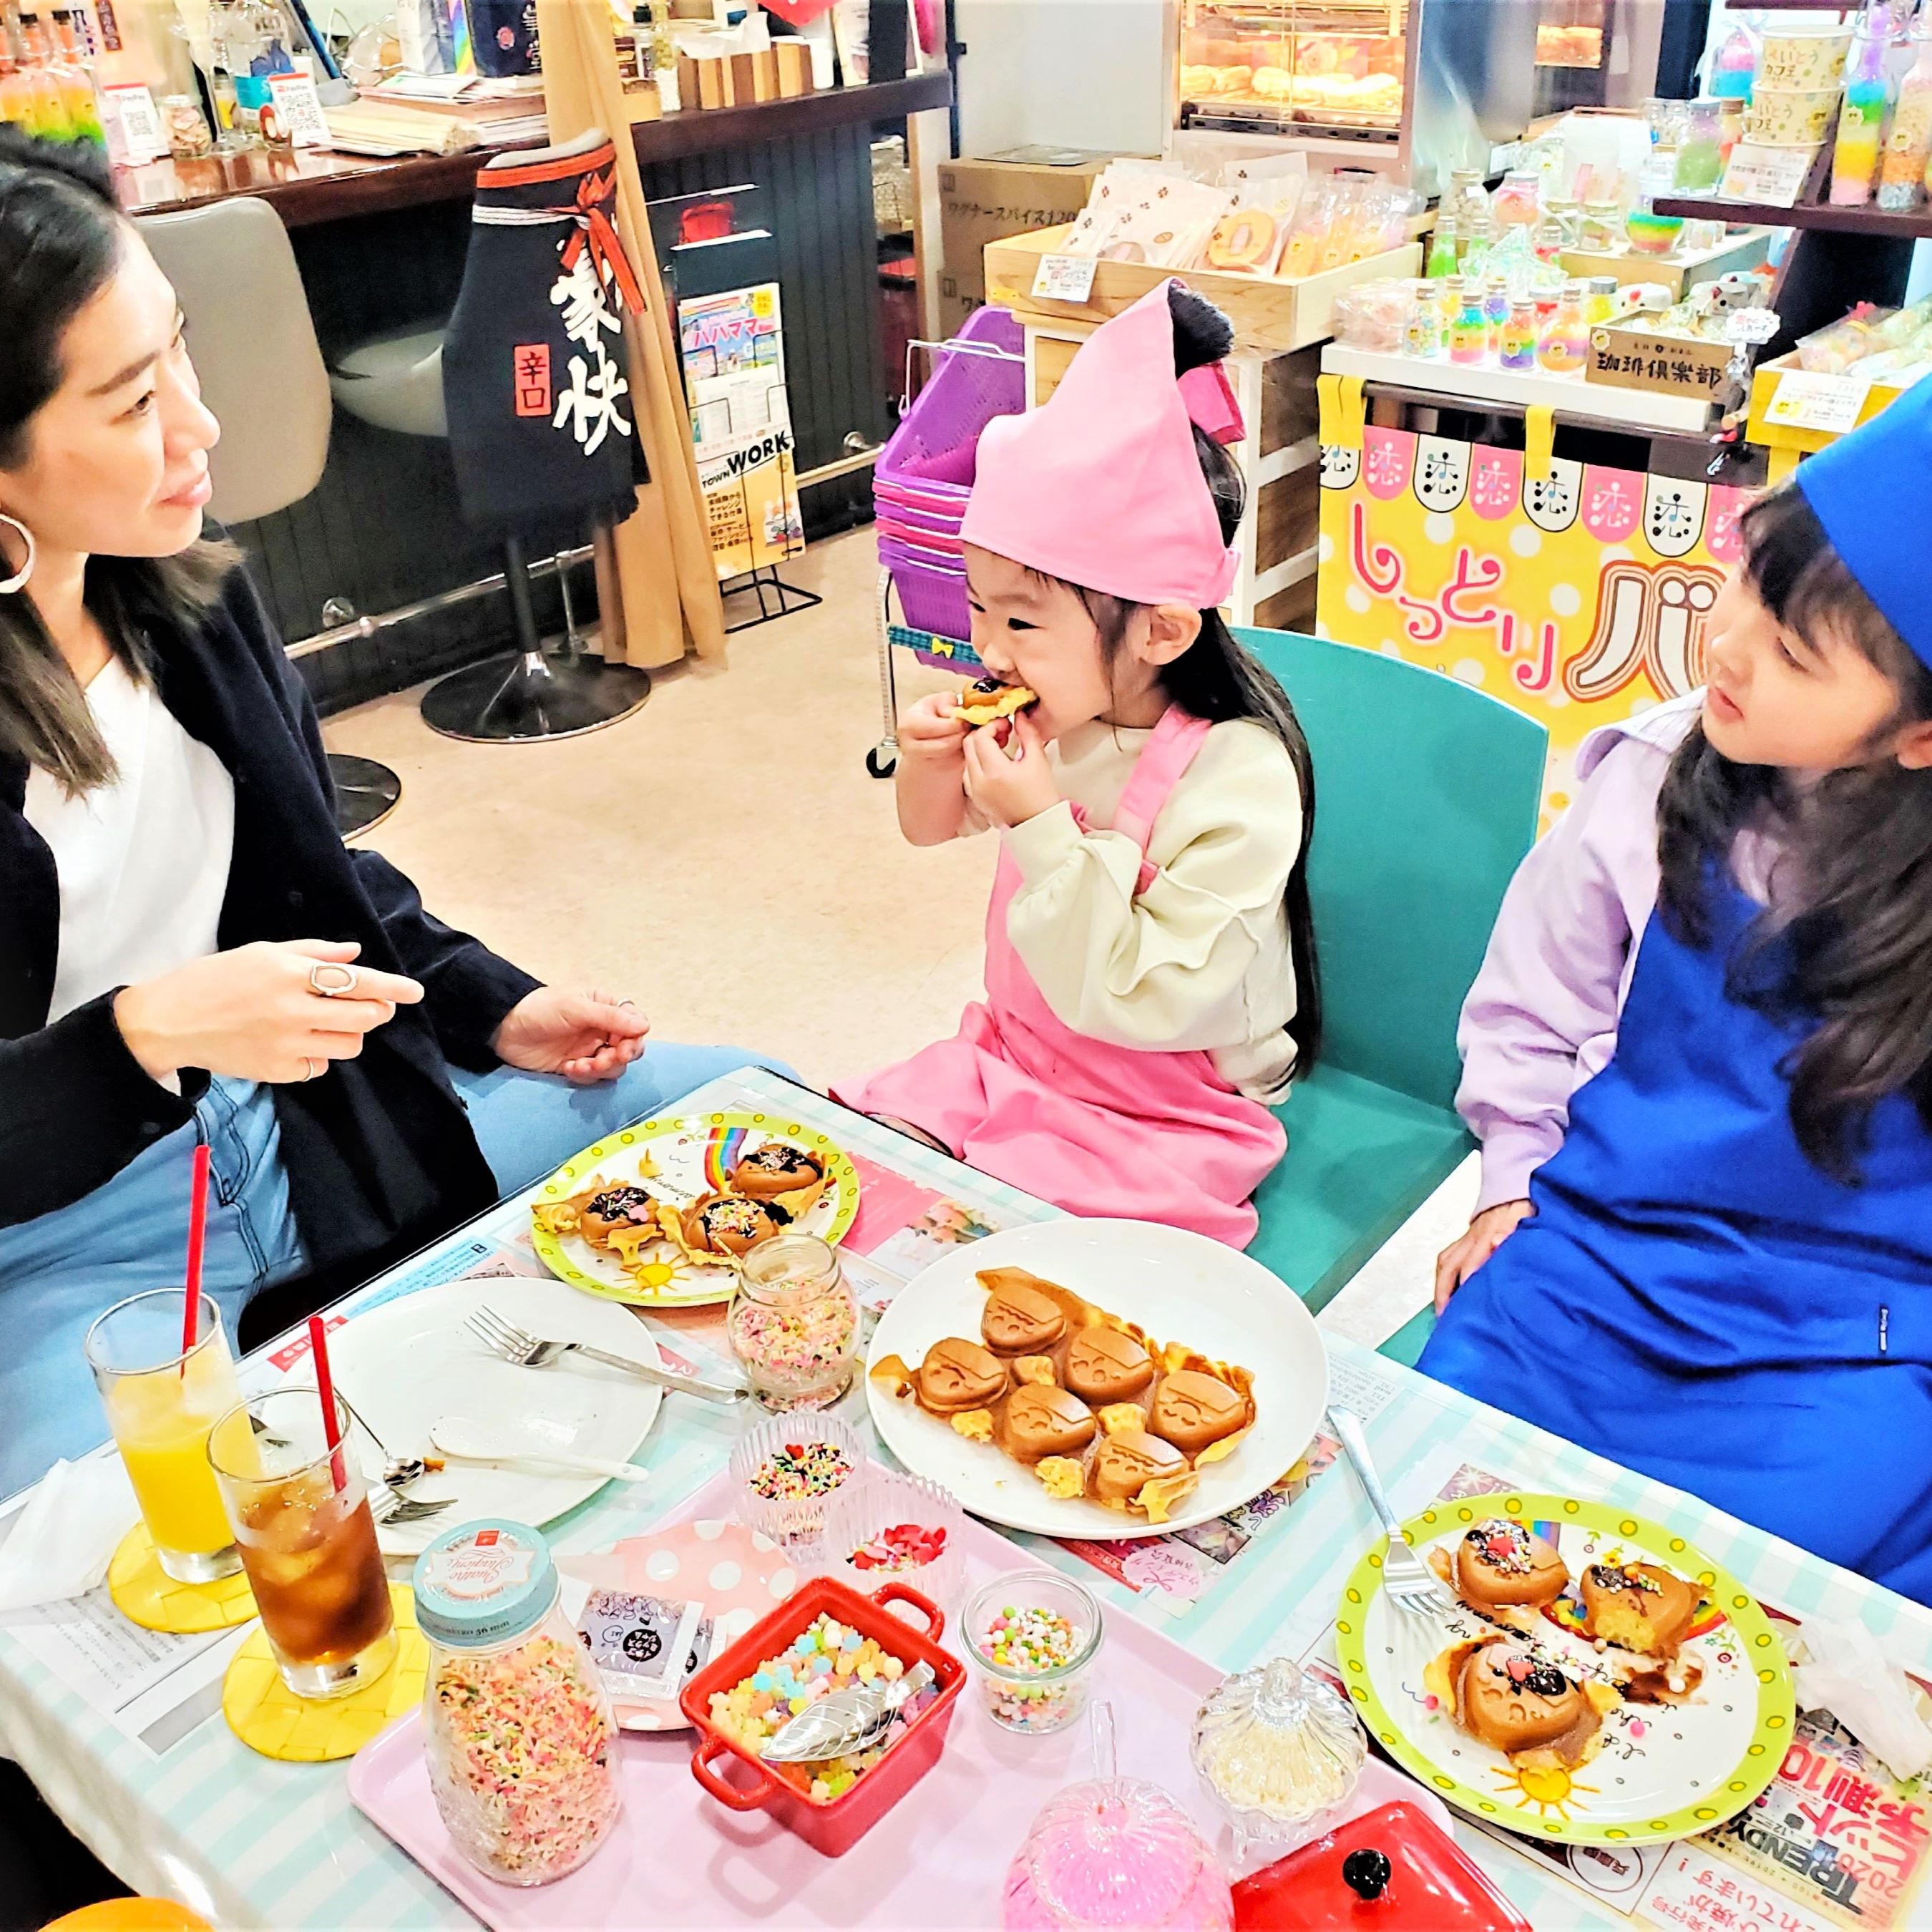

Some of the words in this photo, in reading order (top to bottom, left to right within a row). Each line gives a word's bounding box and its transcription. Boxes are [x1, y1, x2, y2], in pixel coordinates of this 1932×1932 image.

[519, 351, 547, 409] 辛口
[701, 469, 731, 489] TOWN
[727, 429, 791, 474] WORK
[1354, 502, 1555, 691] しっとり
[647, 1174, 694, 1199] armony
[449, 1570, 499, 1584] Quattro
[1725, 1819, 1862, 1914] TRENDY
[1797, 1802, 1916, 1881] ヒット
[1678, 1857, 1815, 1932] れています！
[1835, 1851, 1903, 1898] 2020
